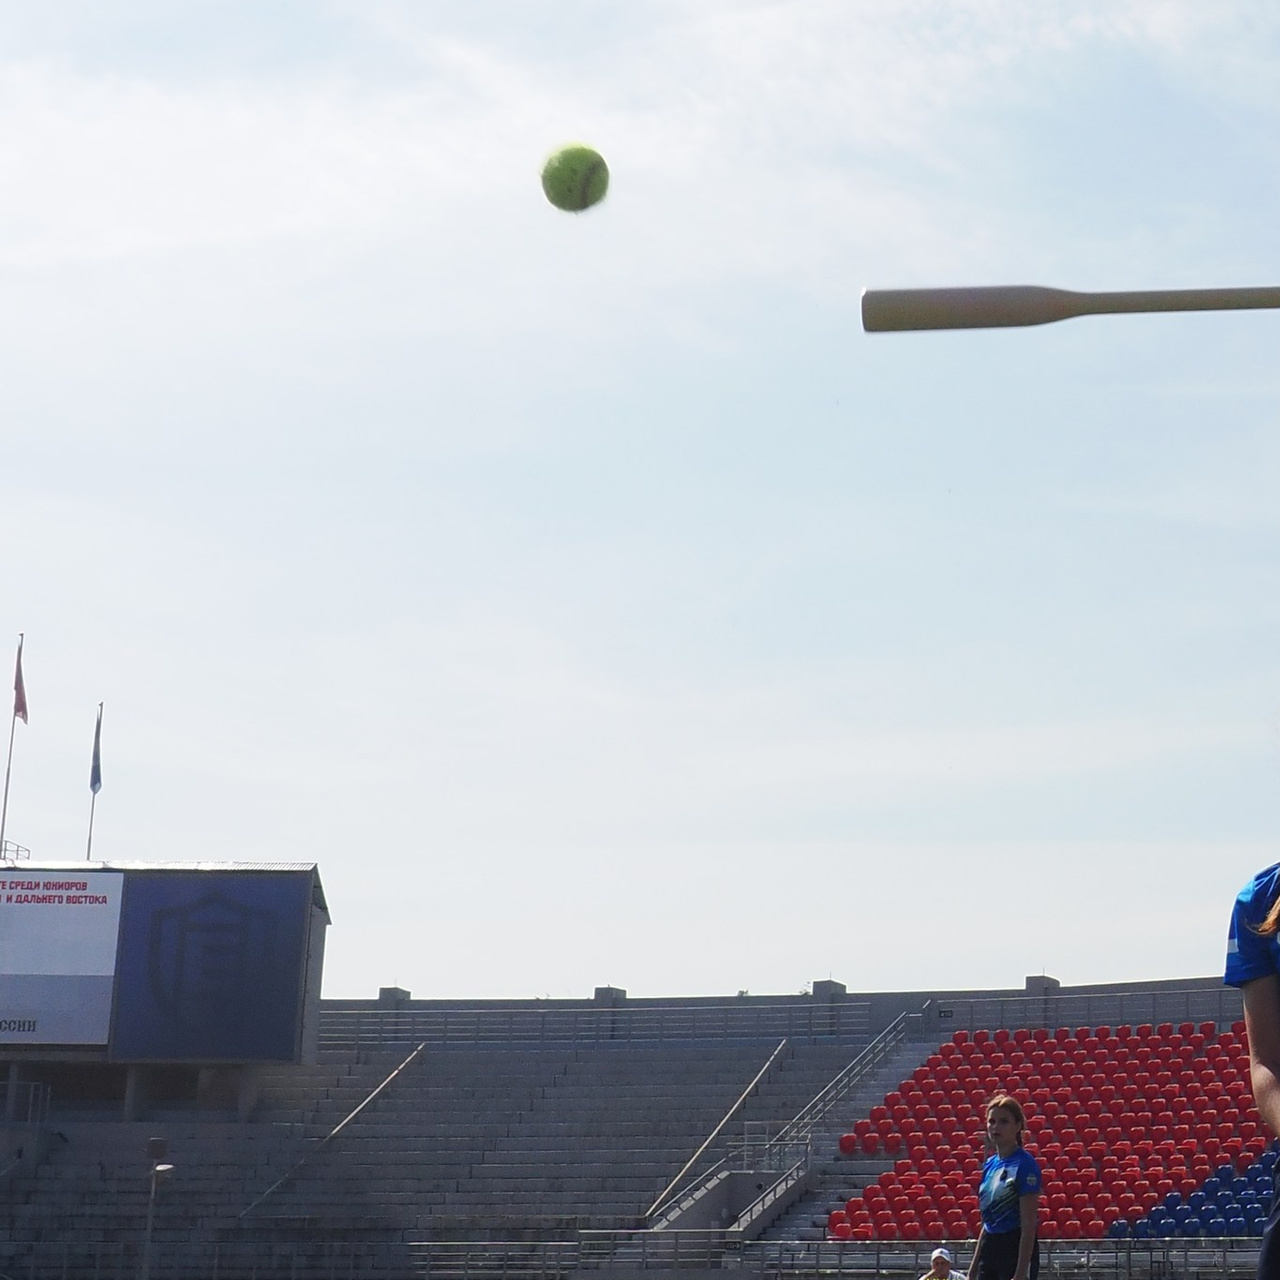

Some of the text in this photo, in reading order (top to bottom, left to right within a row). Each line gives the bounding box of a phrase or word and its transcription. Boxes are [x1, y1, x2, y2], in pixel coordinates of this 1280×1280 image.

[9, 881, 40, 890] СРЕДИ
[43, 881, 88, 891] ЮНИОРОВ
[6, 895, 13, 904] И
[14, 895, 64, 904] ДАЛЬНЕГО
[66, 895, 107, 905] ВОСТОКА
